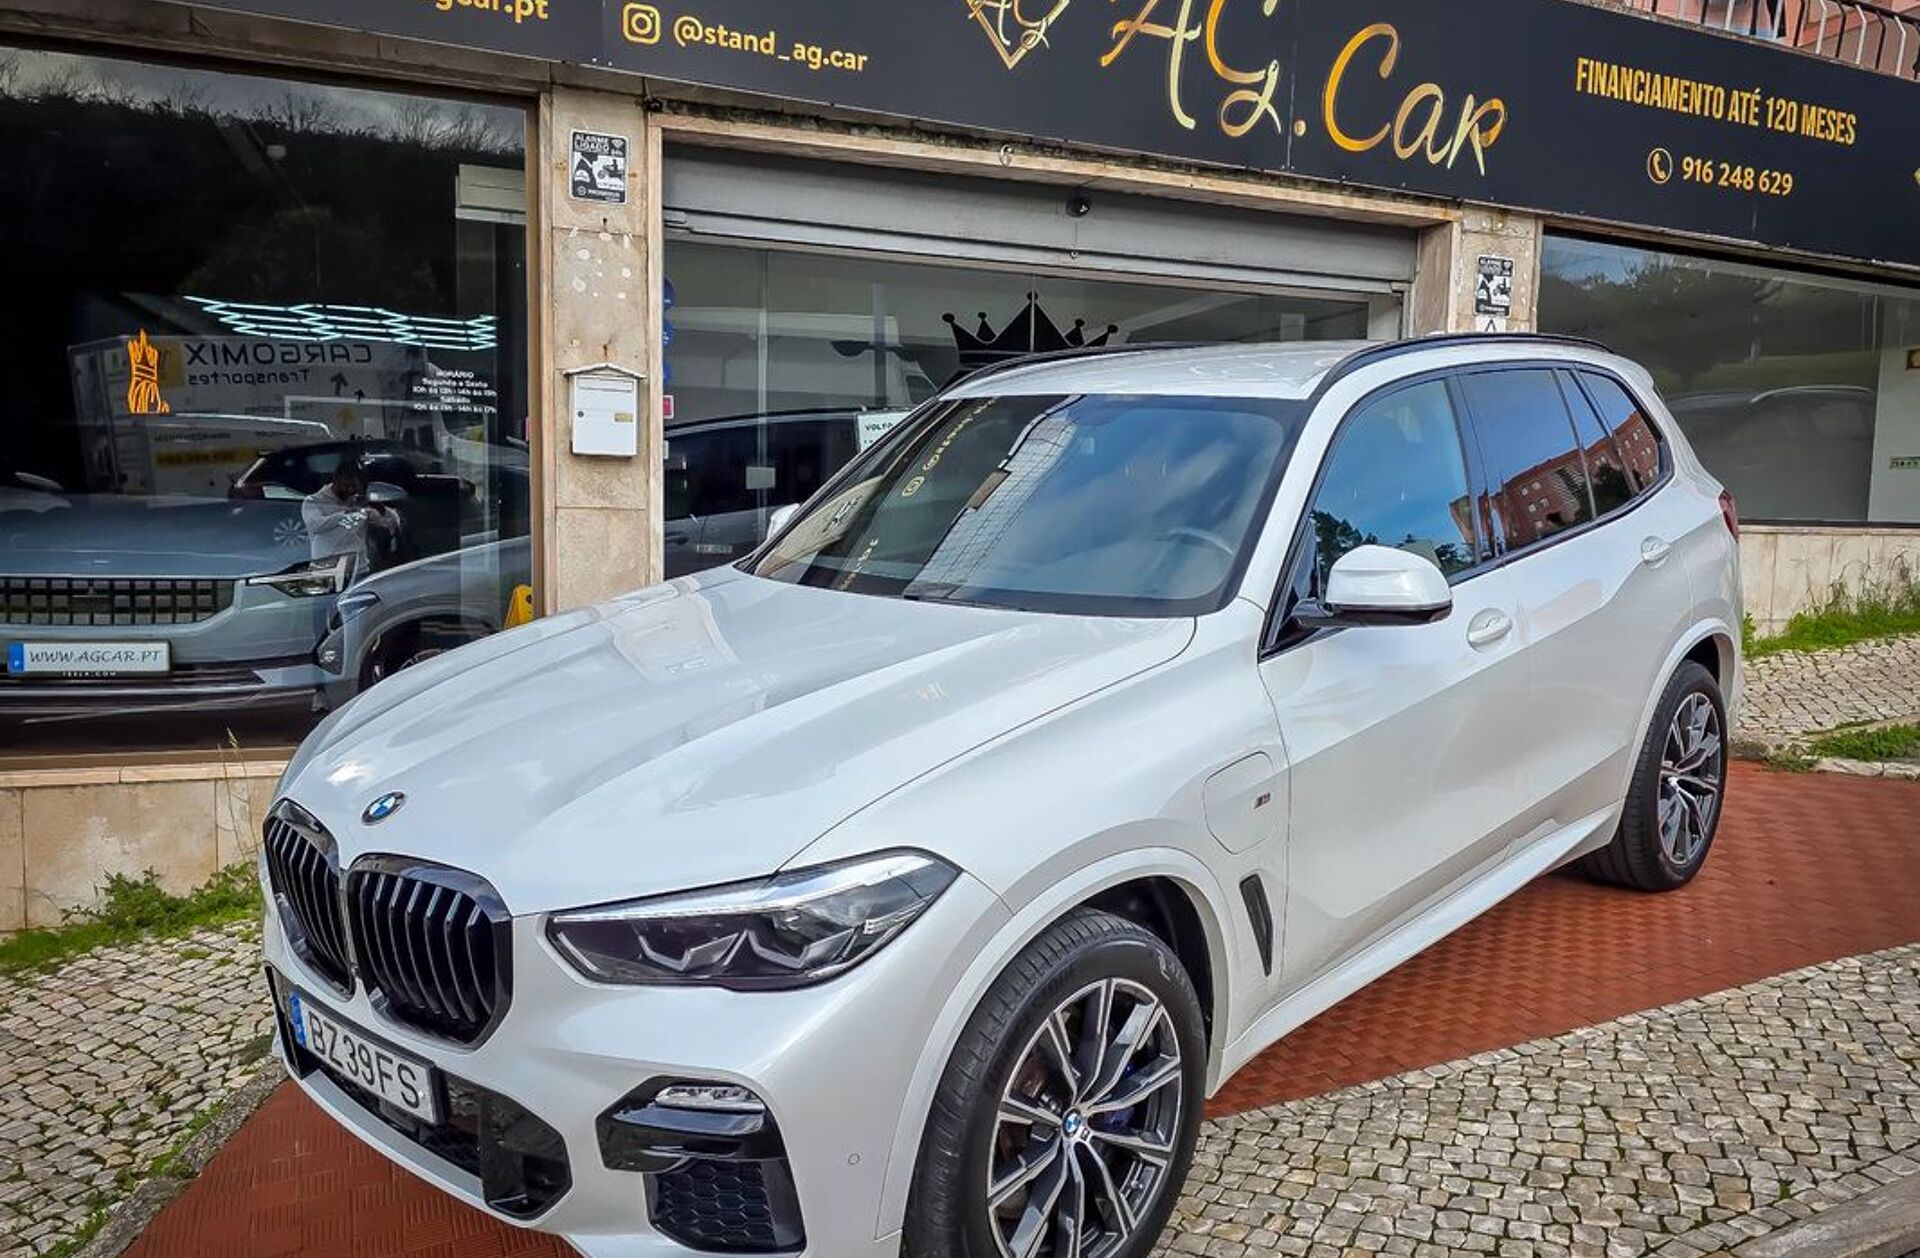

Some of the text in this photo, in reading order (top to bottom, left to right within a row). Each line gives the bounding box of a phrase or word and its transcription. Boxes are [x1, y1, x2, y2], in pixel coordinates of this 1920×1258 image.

[673, 15, 868, 71] @stand_ag.car
[1575, 57, 1857, 145] FINANCIAMENTO ATÉ 120 MESES
[1682, 156, 1793, 196] 916 248 629
[29, 650, 160, 663] WWW.AGCAR.PT
